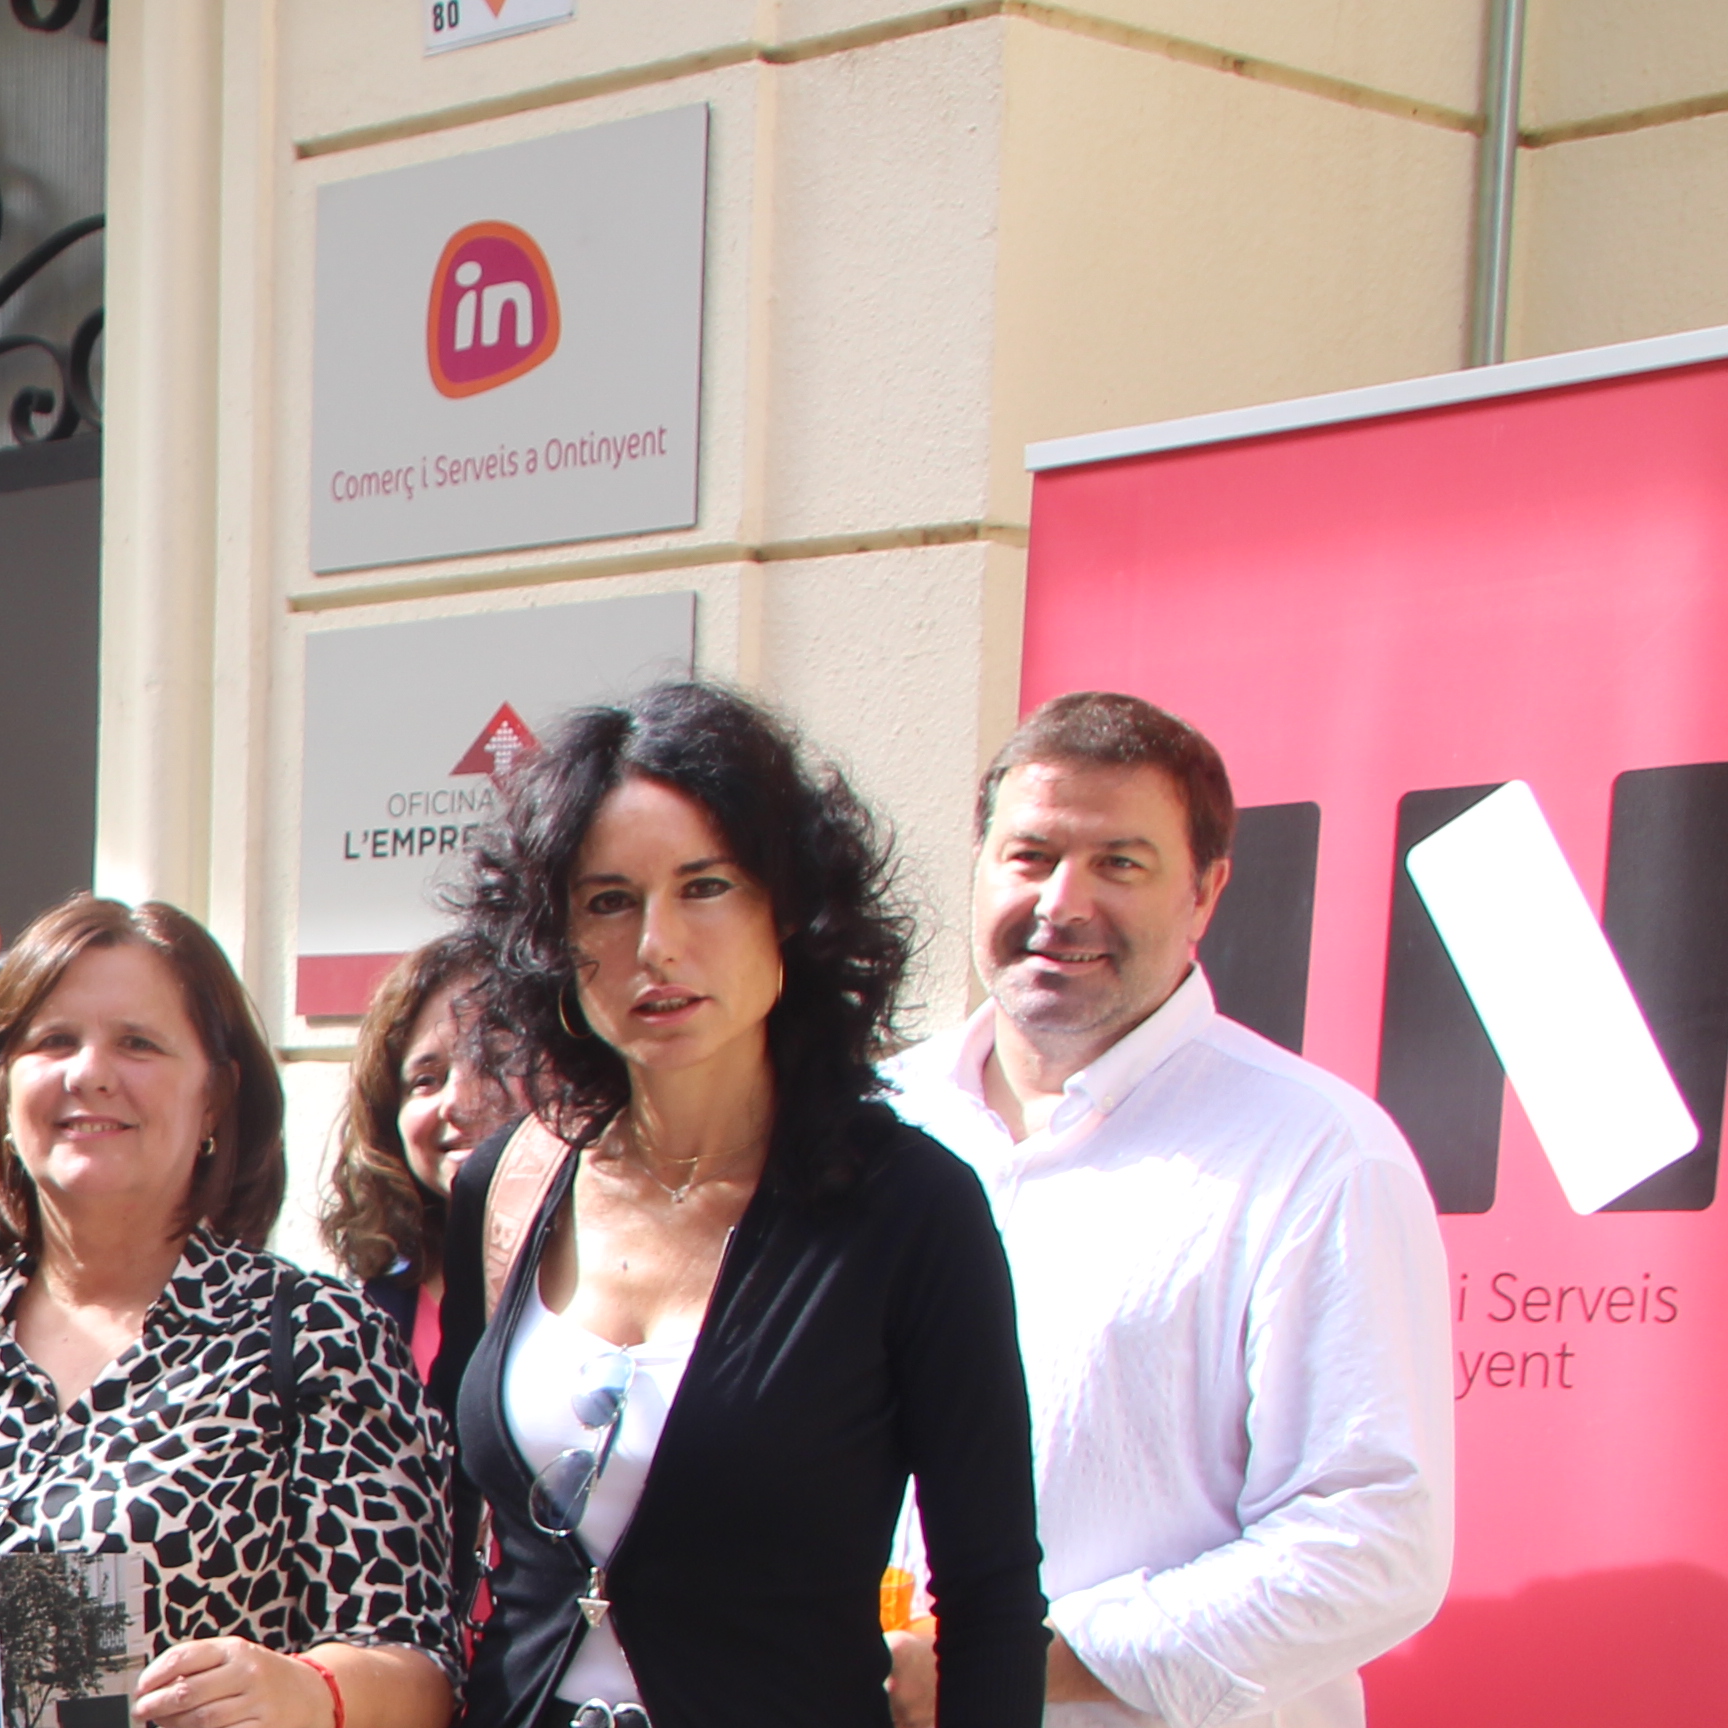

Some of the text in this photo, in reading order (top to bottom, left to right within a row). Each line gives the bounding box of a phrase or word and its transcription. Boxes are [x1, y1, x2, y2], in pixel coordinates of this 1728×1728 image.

[432, 0, 460, 32] 80
[454, 260, 533, 352] in
[331, 424, 668, 501] Comerç i Serveis a Ontinyent
[387, 787, 495, 818] OFICINA
[1458, 1271, 1678, 1323] i Serveis
[1455, 1341, 1575, 1401] yent
